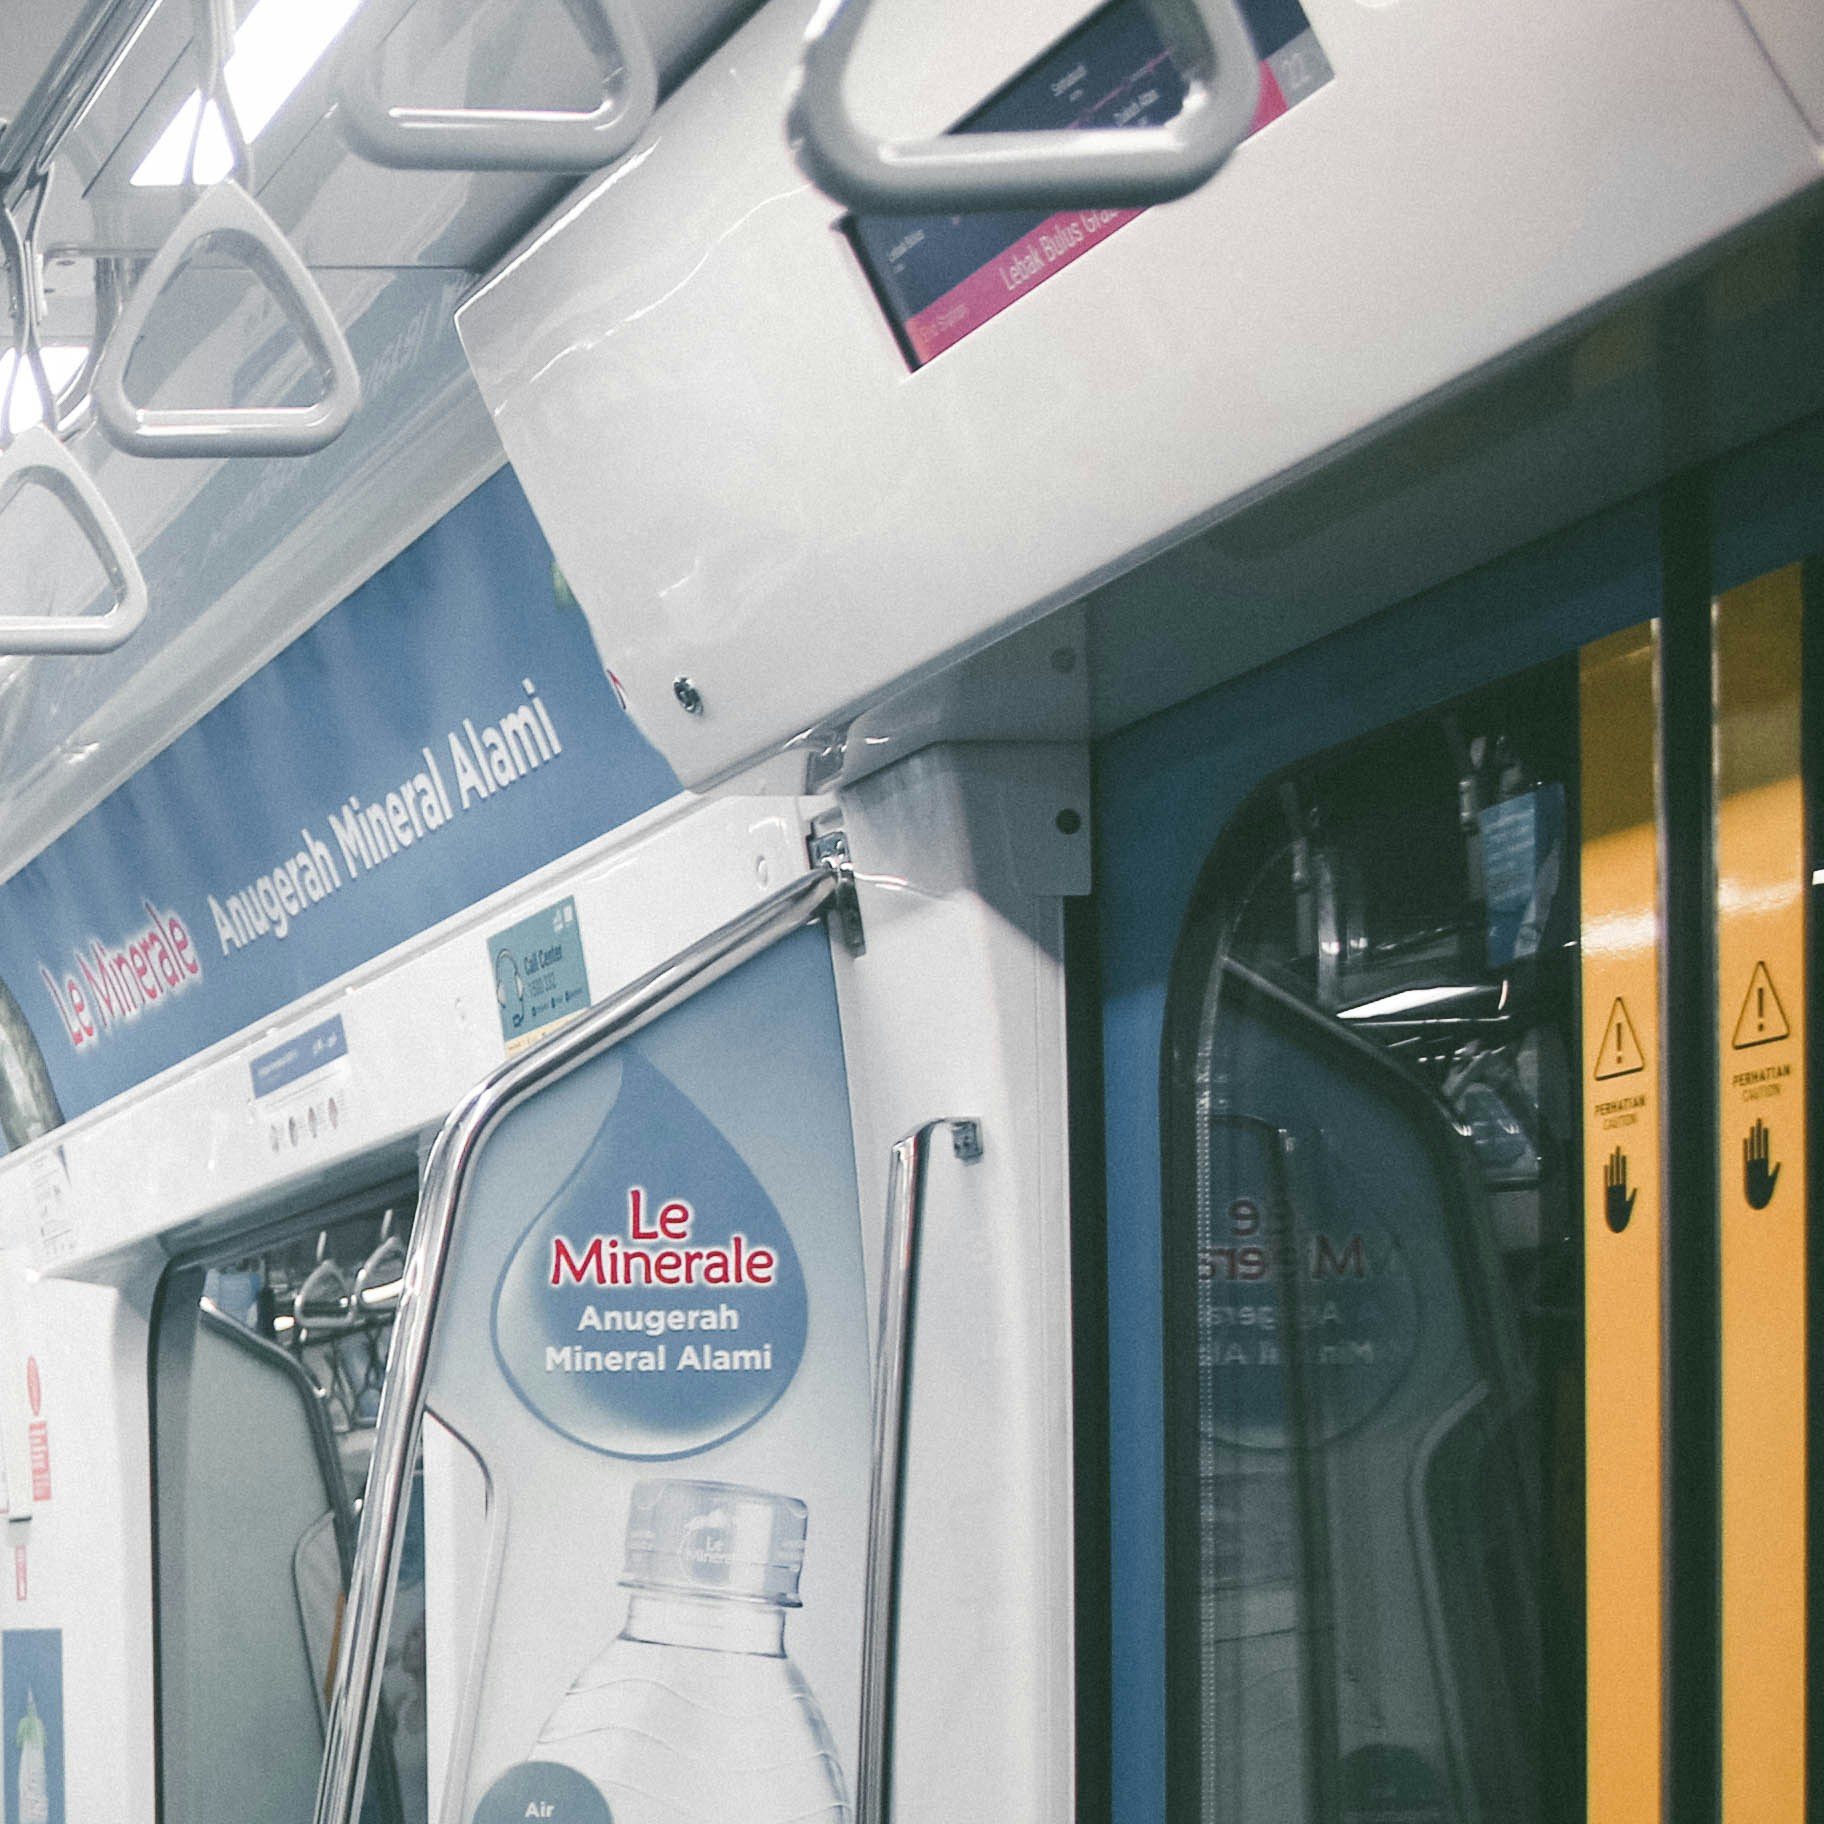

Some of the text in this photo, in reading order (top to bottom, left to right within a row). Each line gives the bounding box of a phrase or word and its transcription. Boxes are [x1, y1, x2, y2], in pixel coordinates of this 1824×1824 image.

[998, 247, 1044, 293] Lebak
[42, 678, 563, 1046] Le Minerale Anugerah Mineral Alami
[1732, 1064, 1791, 1086] PERHATIAN
[1594, 1095, 1646, 1116] PERHATIAN
[630, 1189, 689, 1240] Le
[551, 1236, 774, 1285] Minerale
[577, 1304, 739, 1336] Anugerah
[545, 1343, 772, 1371] Mineral Alami
[525, 1802, 554, 1818] Air
